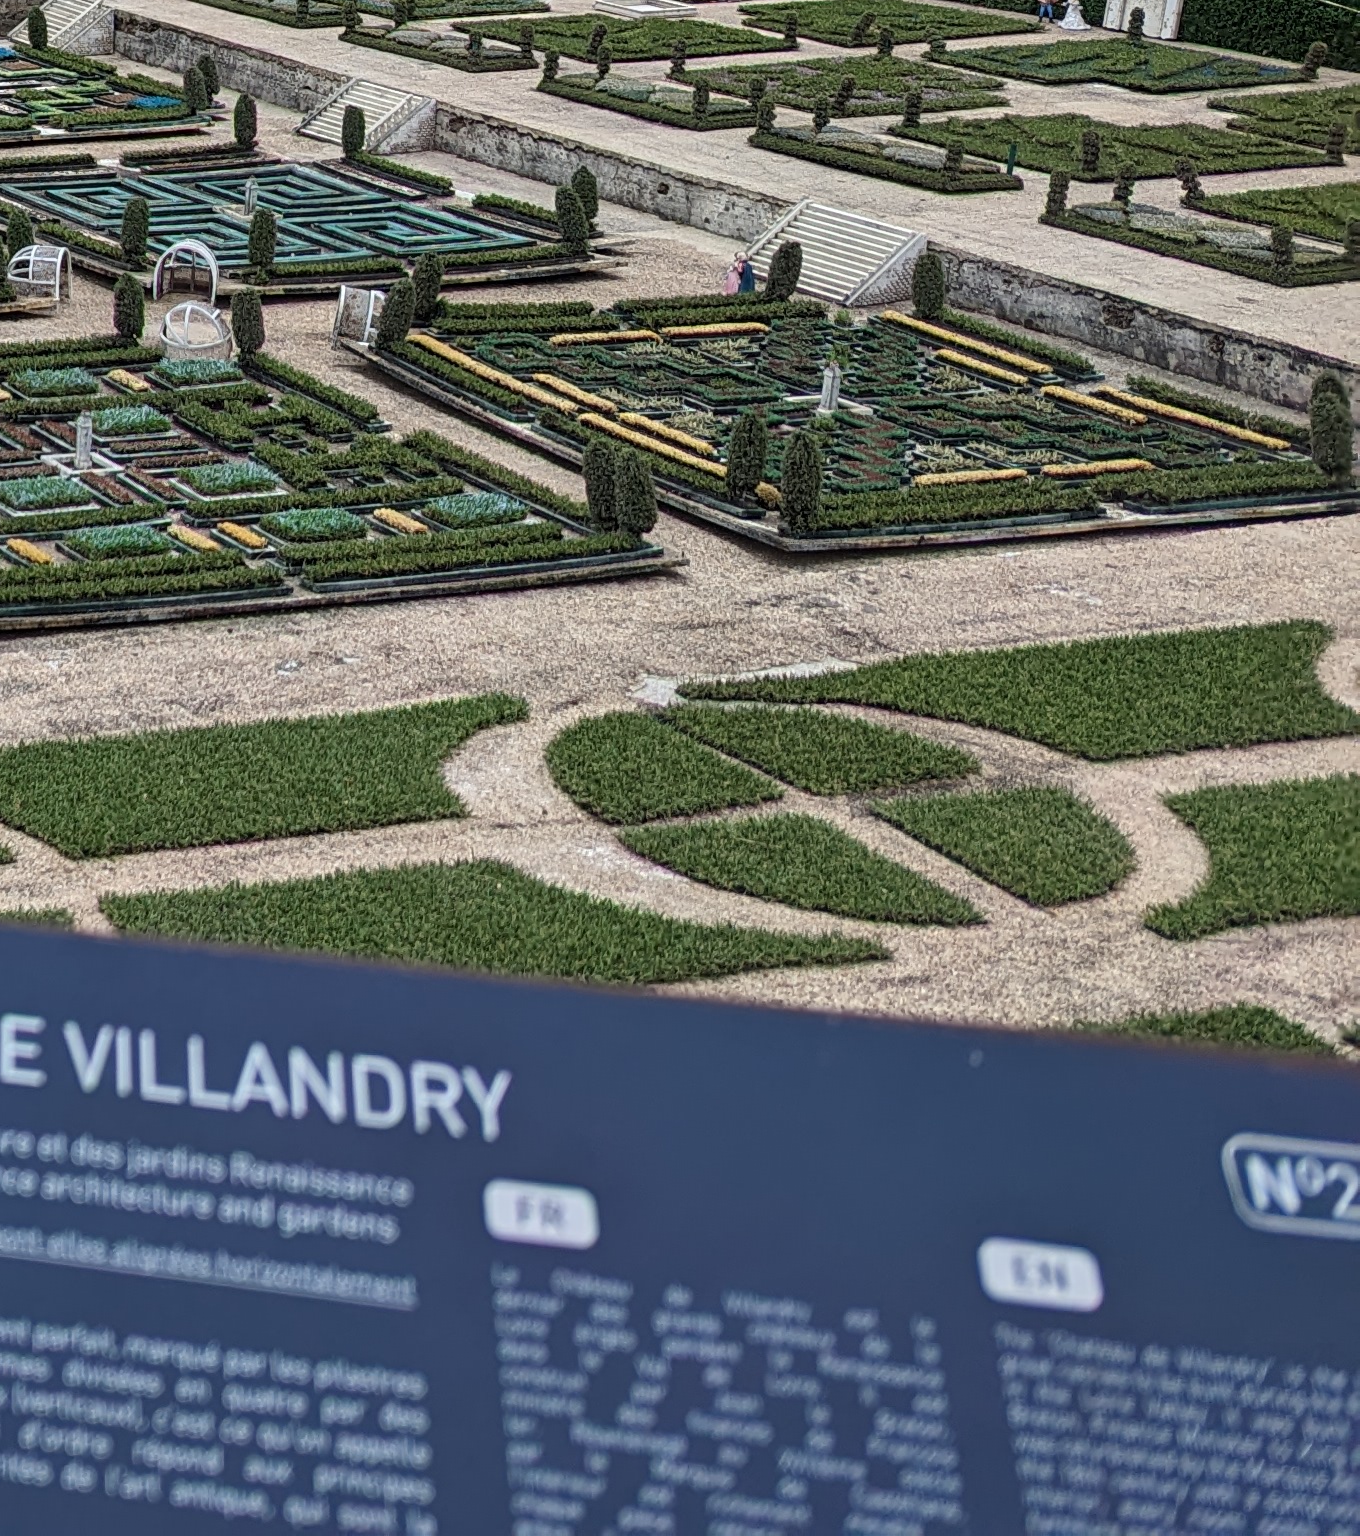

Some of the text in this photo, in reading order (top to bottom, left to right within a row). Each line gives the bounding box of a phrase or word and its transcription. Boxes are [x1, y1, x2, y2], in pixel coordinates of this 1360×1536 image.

[62, 1022, 513, 1143] VILLANDRY
[37, 1133, 68, 1163] et
[71, 1132, 125, 1170] des
[126, 1138, 227, 1183] jardins
[230, 1150, 415, 1207] Renaissance
[40, 1171, 215, 1219] architecture
[218, 1193, 275, 1228] and
[277, 1201, 400, 1245] gardens
[515, 1194, 566, 1229] FR
